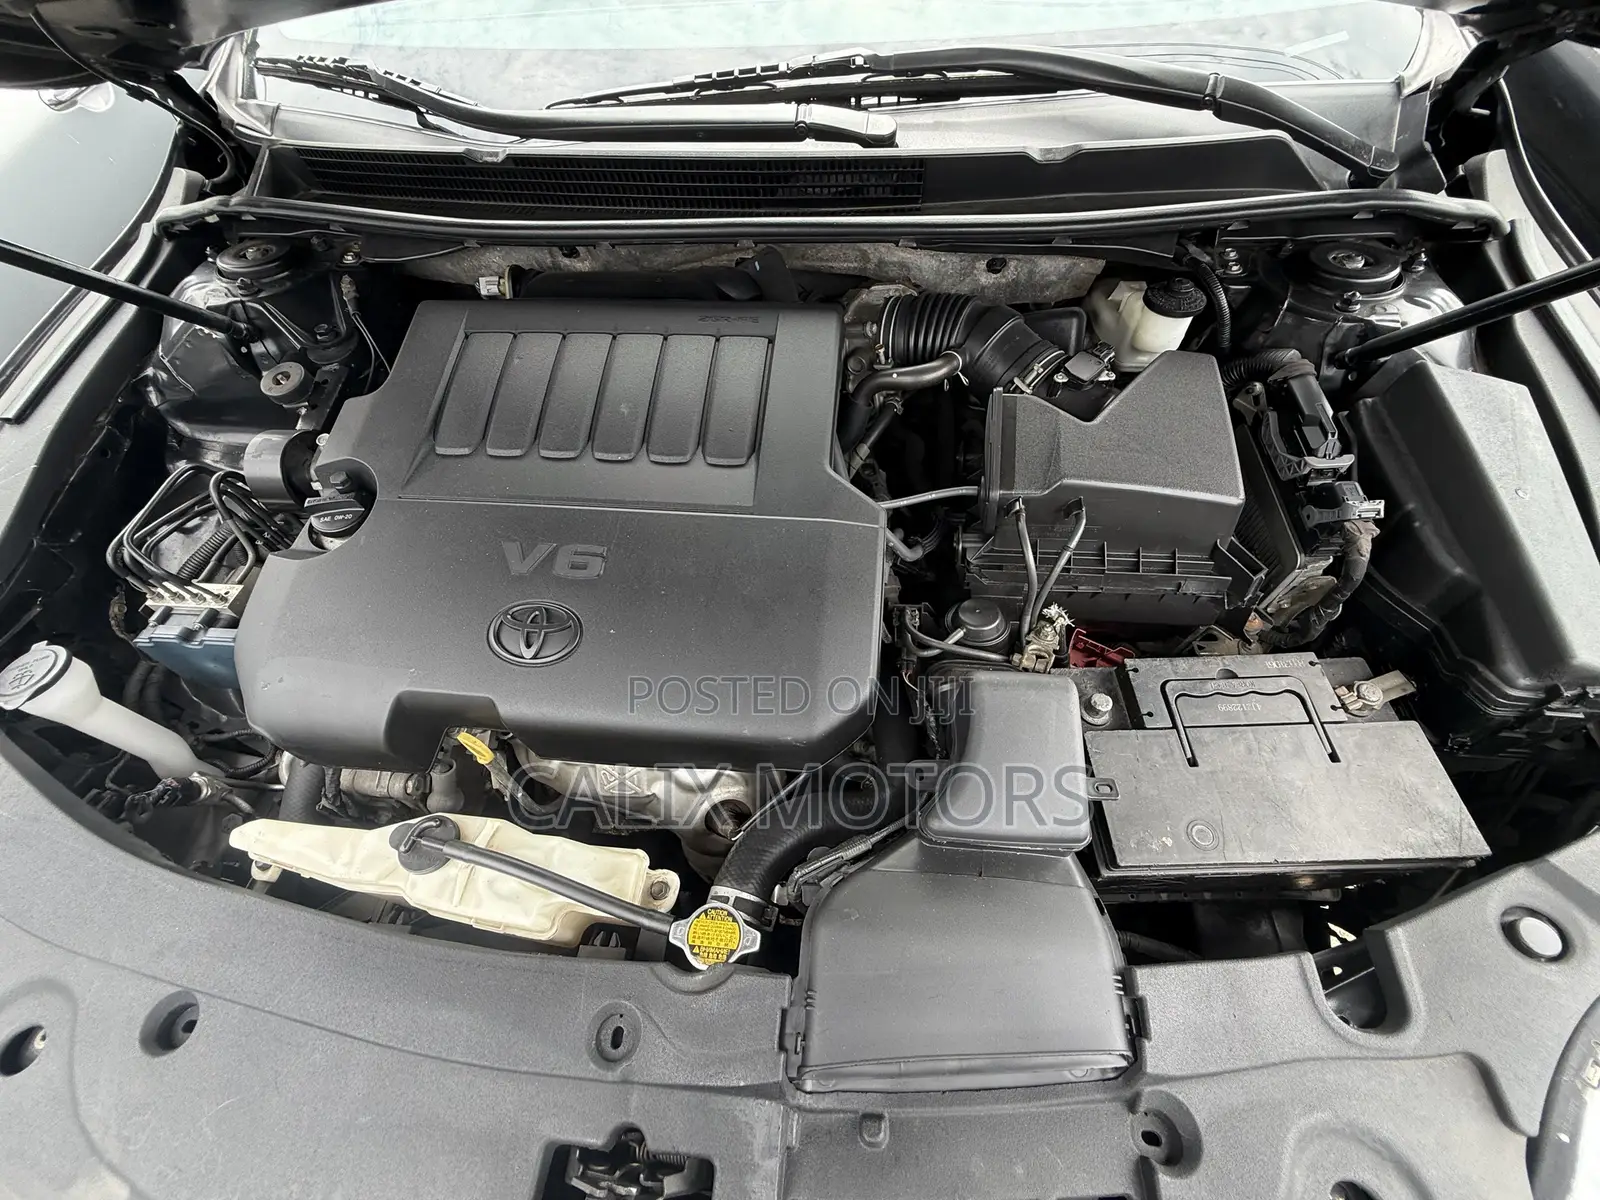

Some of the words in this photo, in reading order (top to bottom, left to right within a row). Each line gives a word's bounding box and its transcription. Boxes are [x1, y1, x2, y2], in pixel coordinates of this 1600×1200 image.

[501, 540, 608, 579] V6
[707, 908, 728, 916] CAUTION
[706, 914, 733, 922] ATTENTION
